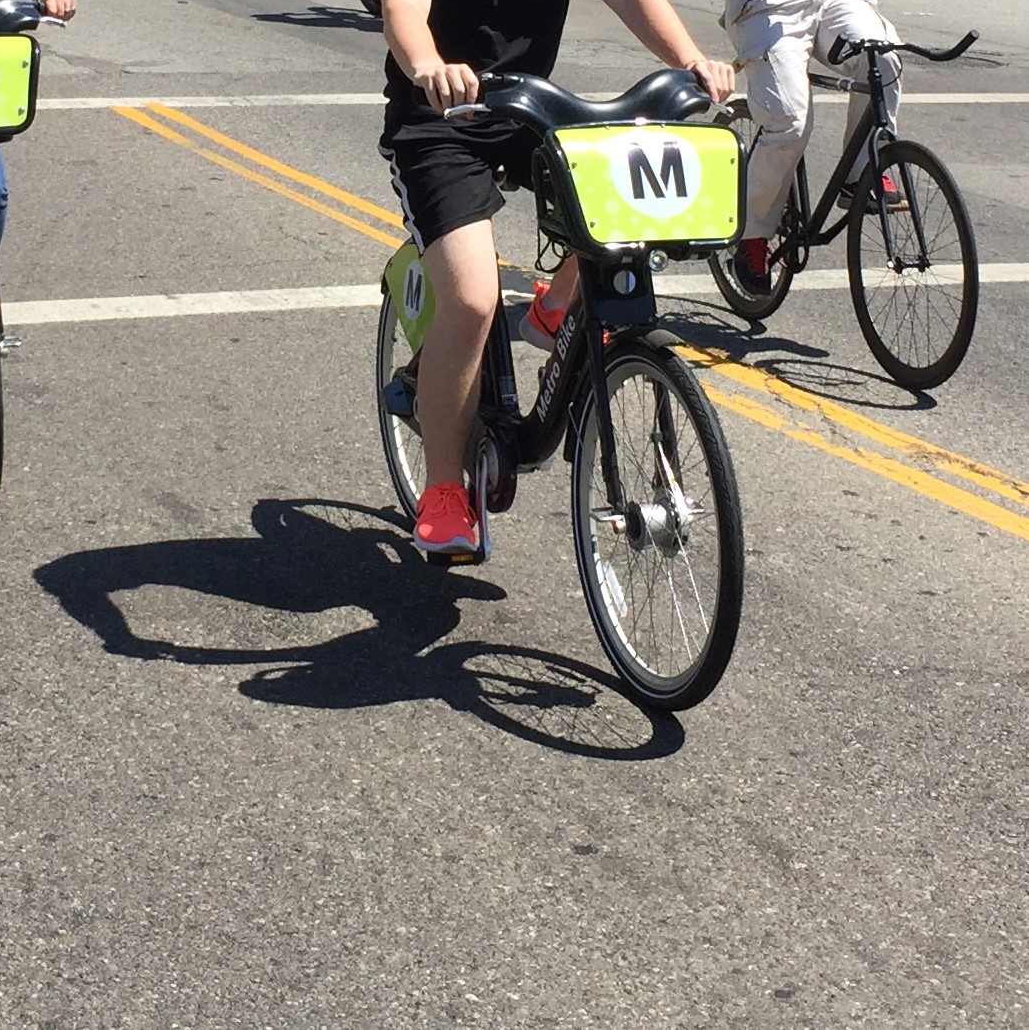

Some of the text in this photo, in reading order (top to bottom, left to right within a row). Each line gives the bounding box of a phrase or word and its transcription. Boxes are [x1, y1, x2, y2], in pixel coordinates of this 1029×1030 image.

[627, 140, 688, 200] M
[405, 269, 423, 312] M
[536, 314, 576, 423] Metro Bike
